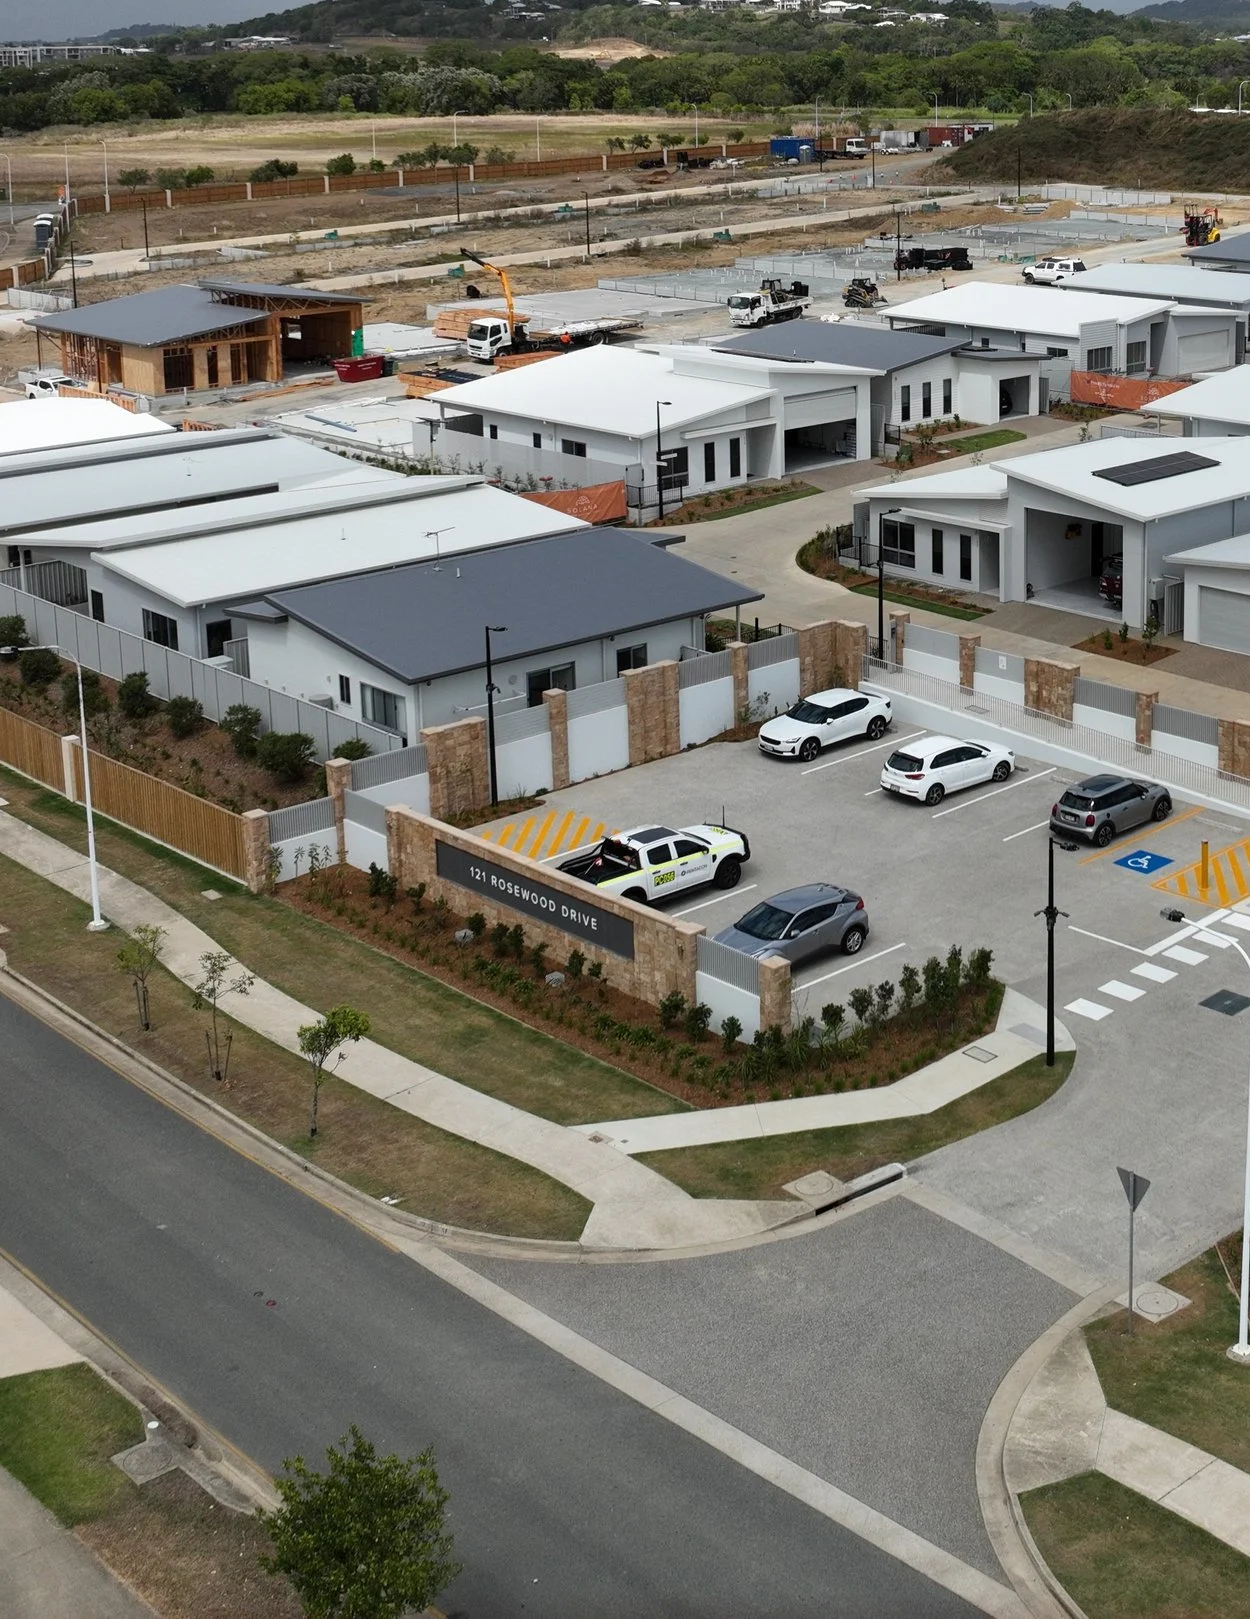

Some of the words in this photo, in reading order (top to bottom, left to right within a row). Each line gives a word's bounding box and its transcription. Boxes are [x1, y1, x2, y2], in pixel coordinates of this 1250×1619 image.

[469, 866, 486, 882] 121
[490, 875, 556, 912] ROSEWOOD
[561, 905, 598, 930] DRIVE
